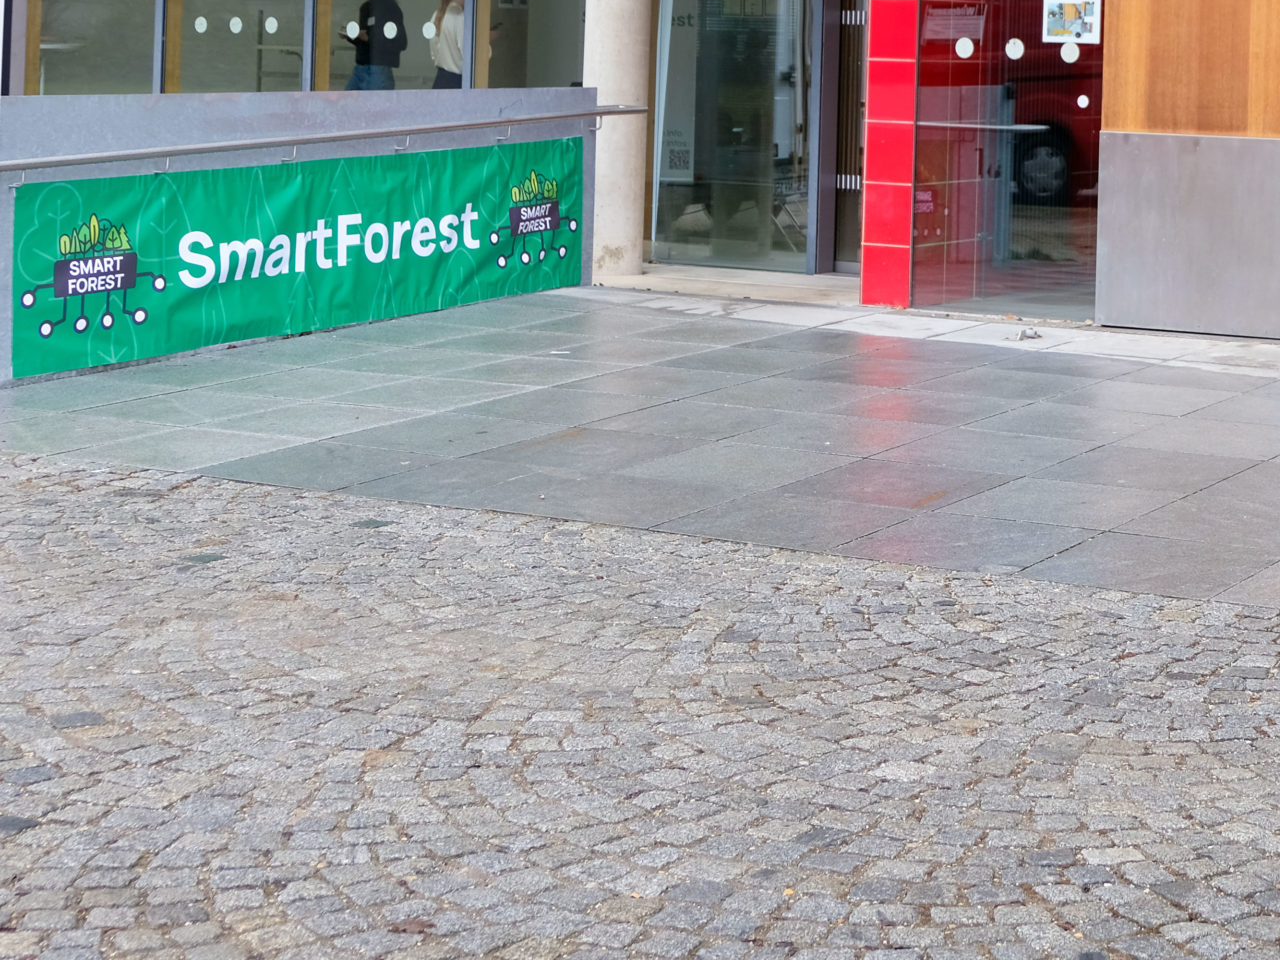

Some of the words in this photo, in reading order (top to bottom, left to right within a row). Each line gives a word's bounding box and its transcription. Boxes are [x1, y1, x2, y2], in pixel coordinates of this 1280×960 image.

[520, 203, 552, 220] SMART
[517, 217, 552, 234] FOREST
[177, 203, 480, 289] SmartForest
[69, 256, 123, 276] SMART
[67, 273, 125, 294] FOREST
